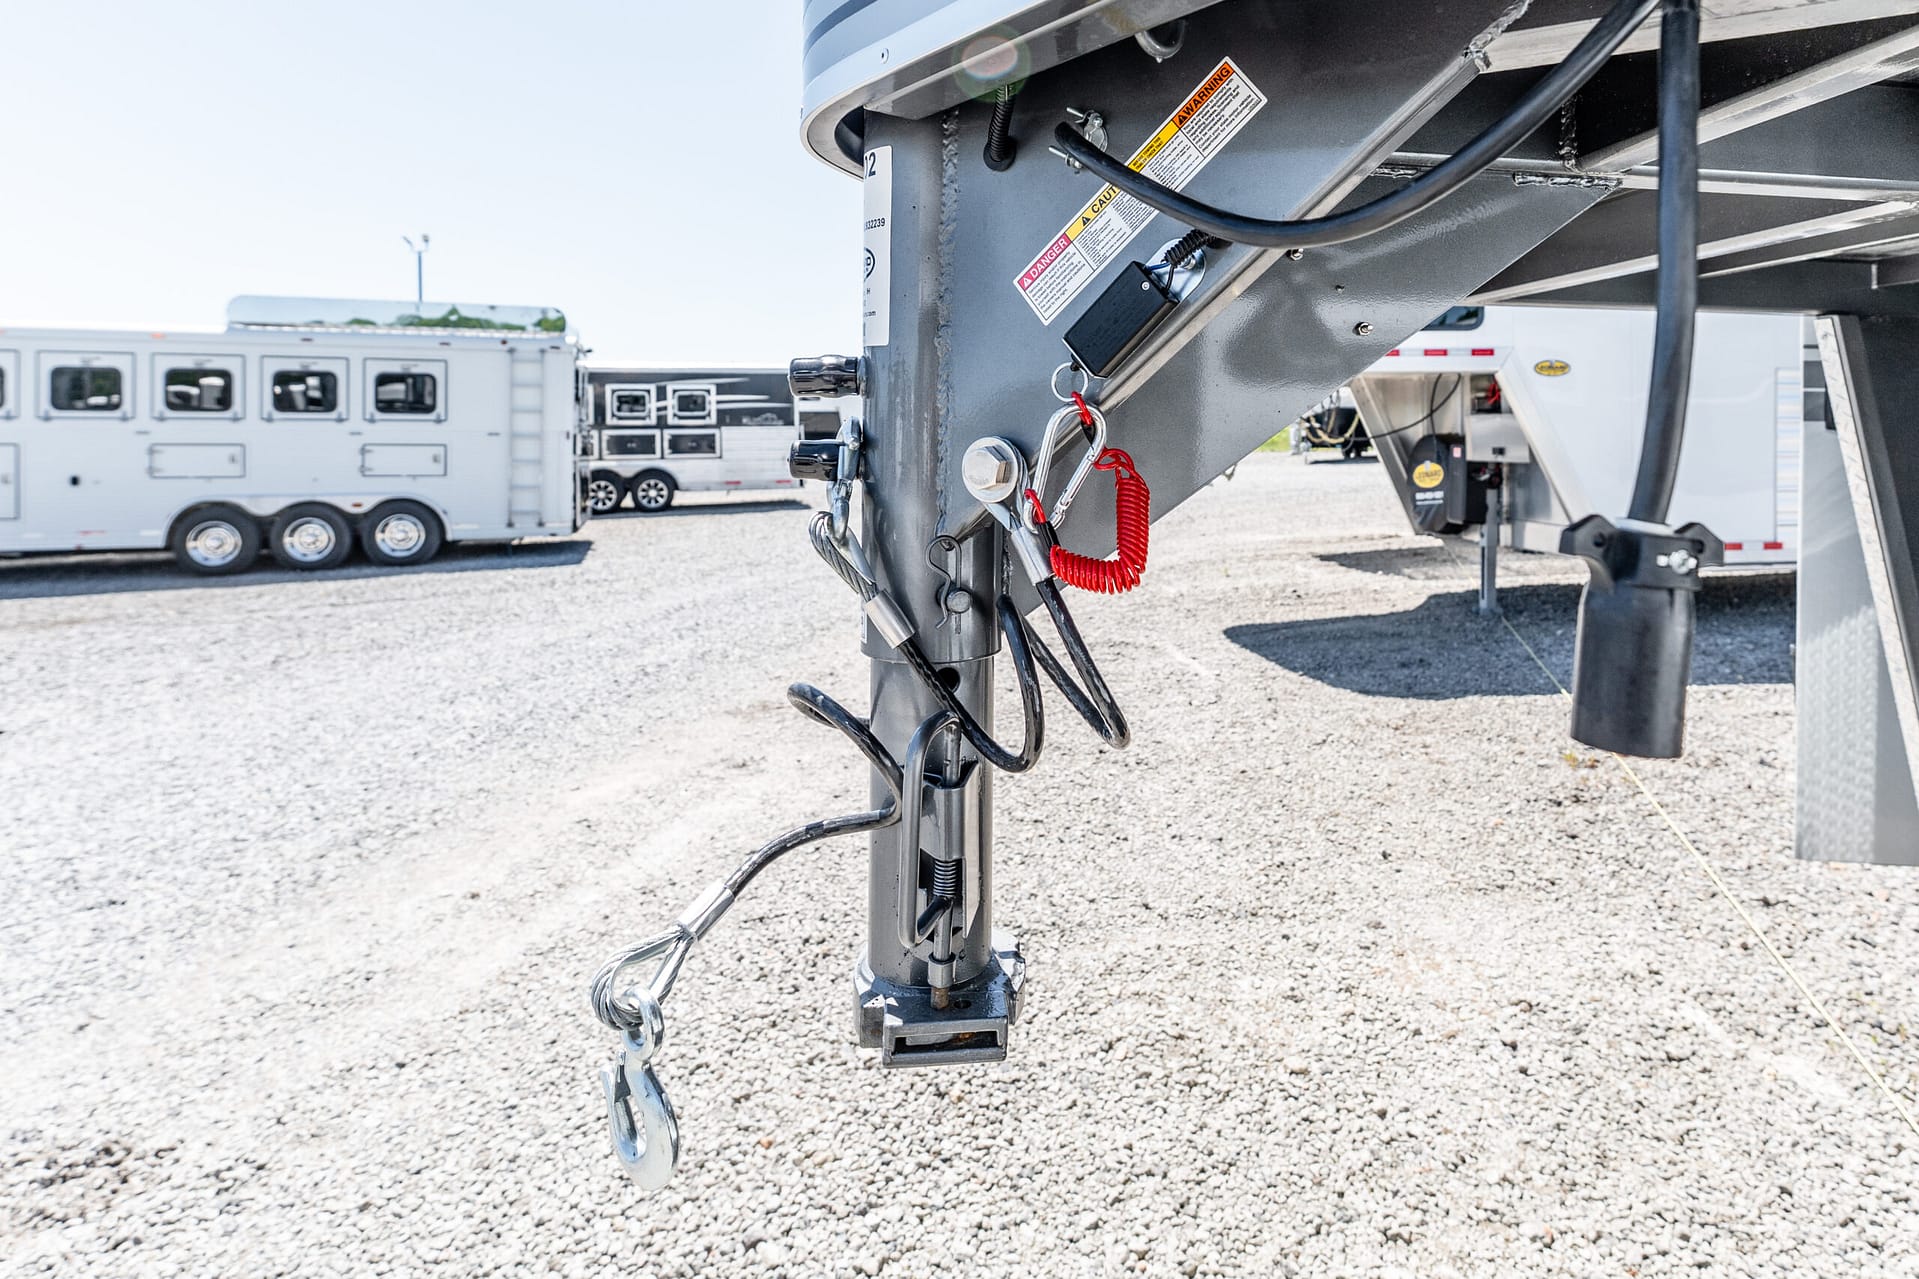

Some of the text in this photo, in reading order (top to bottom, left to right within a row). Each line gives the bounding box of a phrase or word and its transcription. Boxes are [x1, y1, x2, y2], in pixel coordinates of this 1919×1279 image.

[1182, 66, 1230, 117] WARNING
[1090, 185, 1117, 214] CAUT
[1029, 237, 1067, 278] DANGER
